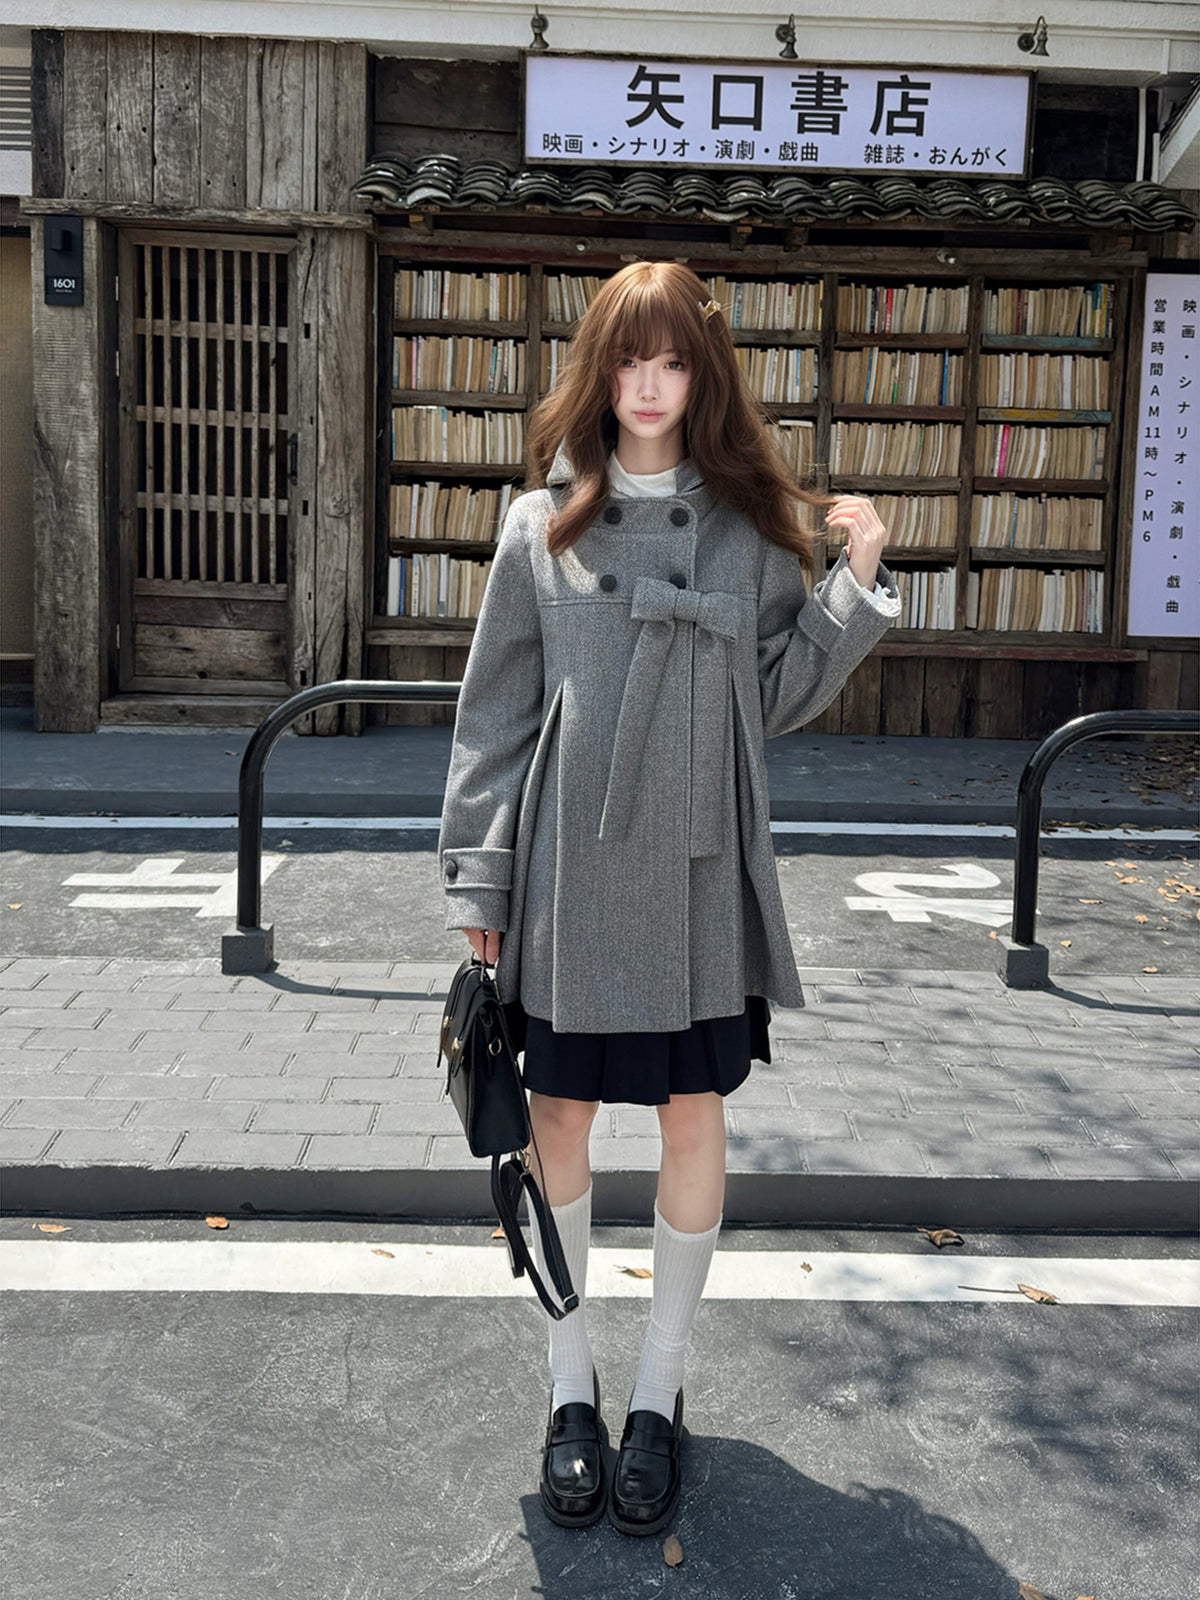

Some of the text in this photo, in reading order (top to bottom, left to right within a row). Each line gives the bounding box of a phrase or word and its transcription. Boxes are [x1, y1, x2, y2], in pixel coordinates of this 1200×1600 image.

[626, 65, 932, 137] 矢口書店
[864, 144, 1007, 167] 雑誌・おんがく
[53, 279, 76, 289] 1601
